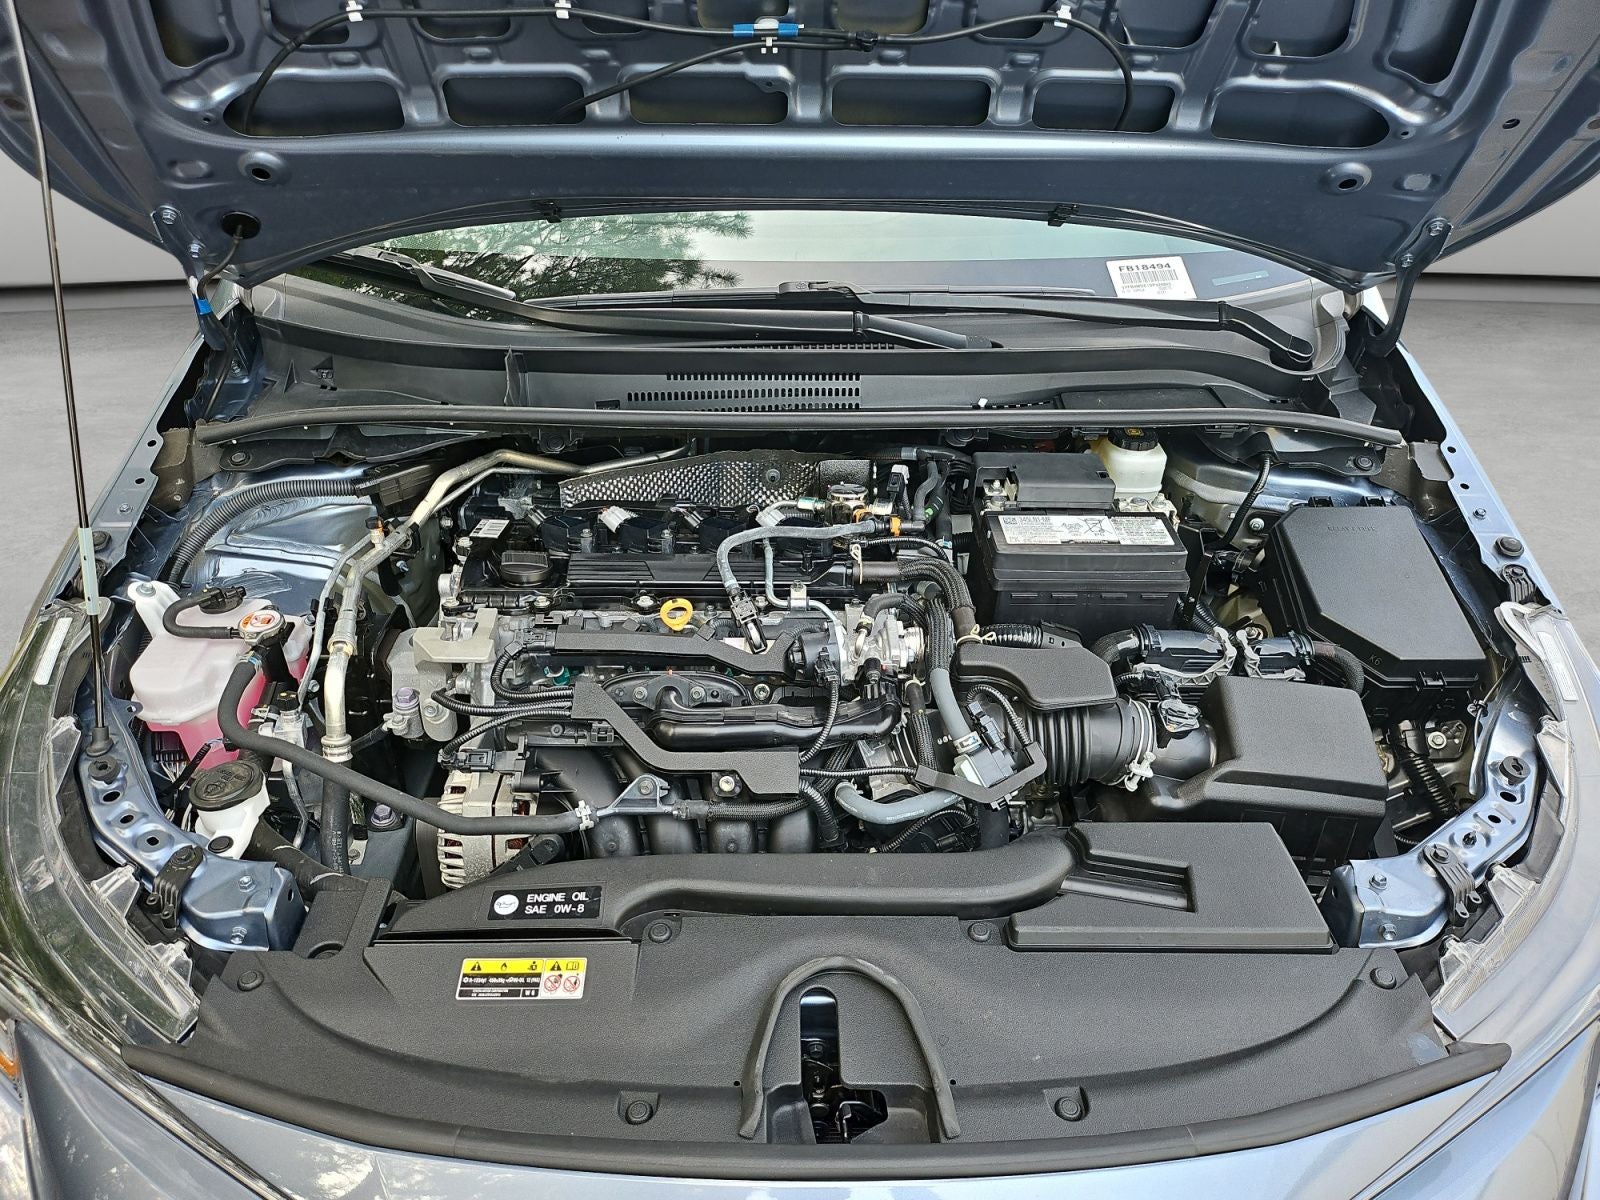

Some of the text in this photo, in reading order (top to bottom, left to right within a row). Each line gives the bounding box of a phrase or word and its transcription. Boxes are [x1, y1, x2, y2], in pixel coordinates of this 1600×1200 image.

[1119, 263, 1171, 272] FB18494
[526, 892, 589, 902] ENGINE OIL
[525, 904, 585, 914] SAE 0W-8
